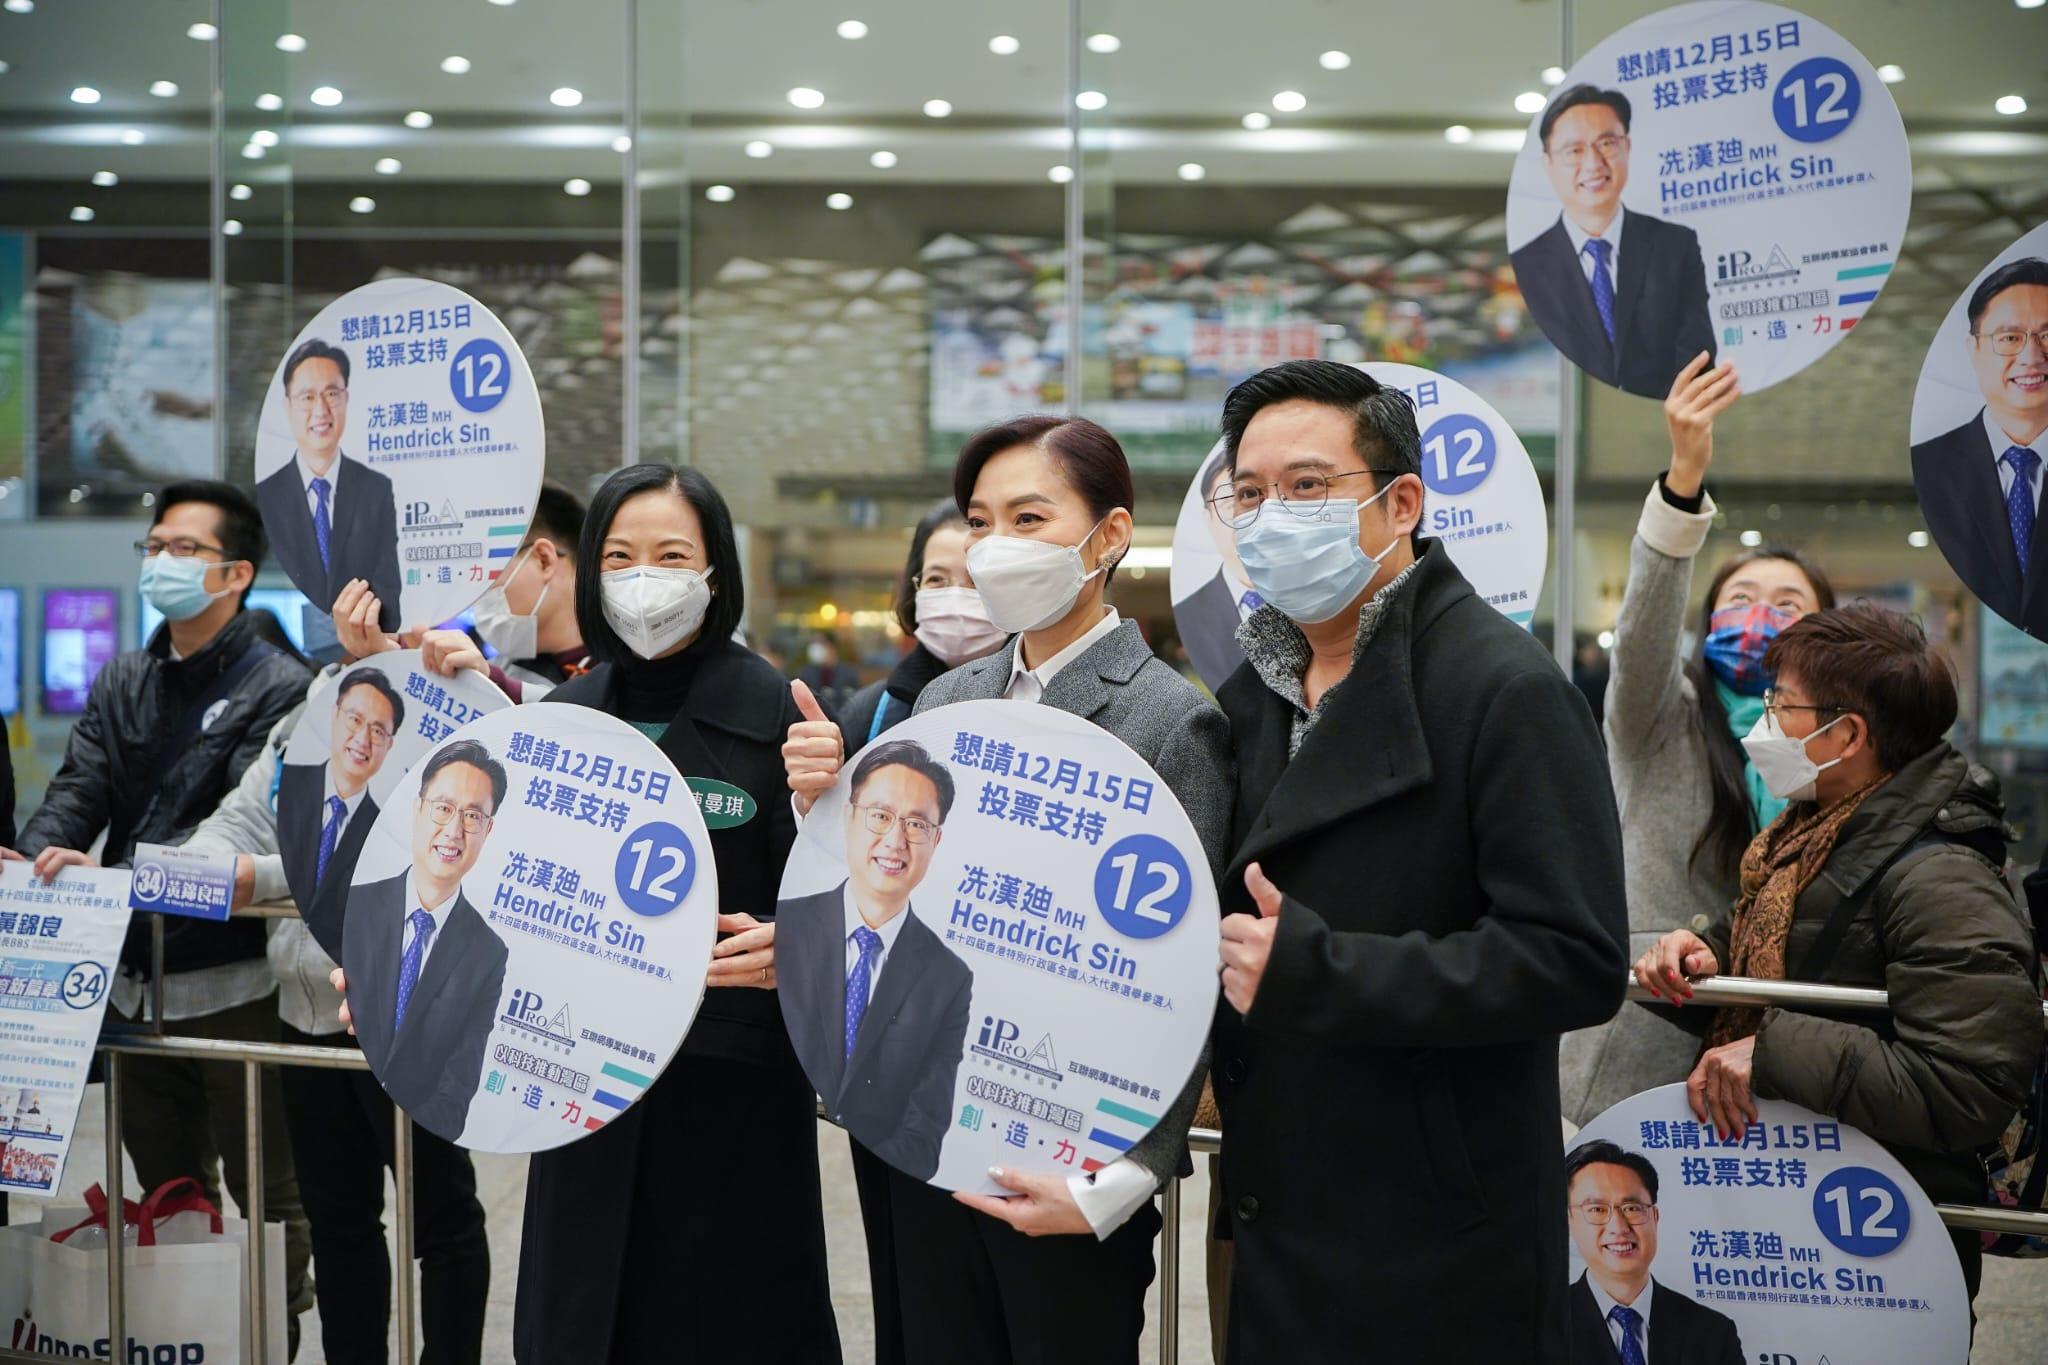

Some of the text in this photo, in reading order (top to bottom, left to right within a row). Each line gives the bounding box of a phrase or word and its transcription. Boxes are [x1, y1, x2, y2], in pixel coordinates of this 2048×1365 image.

[1617, 20, 1800, 83] 懇請12月15日
[1653, 62, 1769, 110] 投票支持
[1783, 72, 1849, 128] 12
[1749, 144, 1777, 162] MH
[1660, 155, 1833, 202] Hendrick Sin
[341, 304, 471, 342] 懇請12月15日
[366, 338, 448, 369] 投票支持
[456, 353, 503, 398] 12
[368, 424, 490, 452] Hendrick Sin
[432, 411, 452, 423] MH
[1424, 428, 1486, 481] 12
[1433, 506, 1474, 531] Sin
[505, 731, 672, 805] 懇請12月15日
[950, 731, 1154, 815] 懇請12月15日
[524, 775, 631, 833] 投票支持
[978, 781, 1108, 846] 投票支持
[138, 869, 161, 894] 34
[627, 838, 686, 903] 12
[1109, 852, 1180, 925] 12
[493, 883, 645, 954] Hendrick Sin
[579, 887, 606, 911] MH
[1054, 907, 1086, 931] MH
[950, 899, 1136, 980] Hendrick Sin
[65, 972, 101, 999] 34
[494, 1044, 590, 1094] 以科技推動灣區
[580, 1028, 657, 1064] 互聯網專業協會會長
[966, 1075, 1083, 1133] 以科技推動灣區
[1068, 1061, 1161, 1101] 互聯網專業協會會長
[1681, 1157, 1807, 1189] 投票支持
[1824, 1185, 1898, 1238] 12
[1693, 1262, 1884, 1293] Hendrick Sin
[1789, 1246, 1820, 1263] MH
